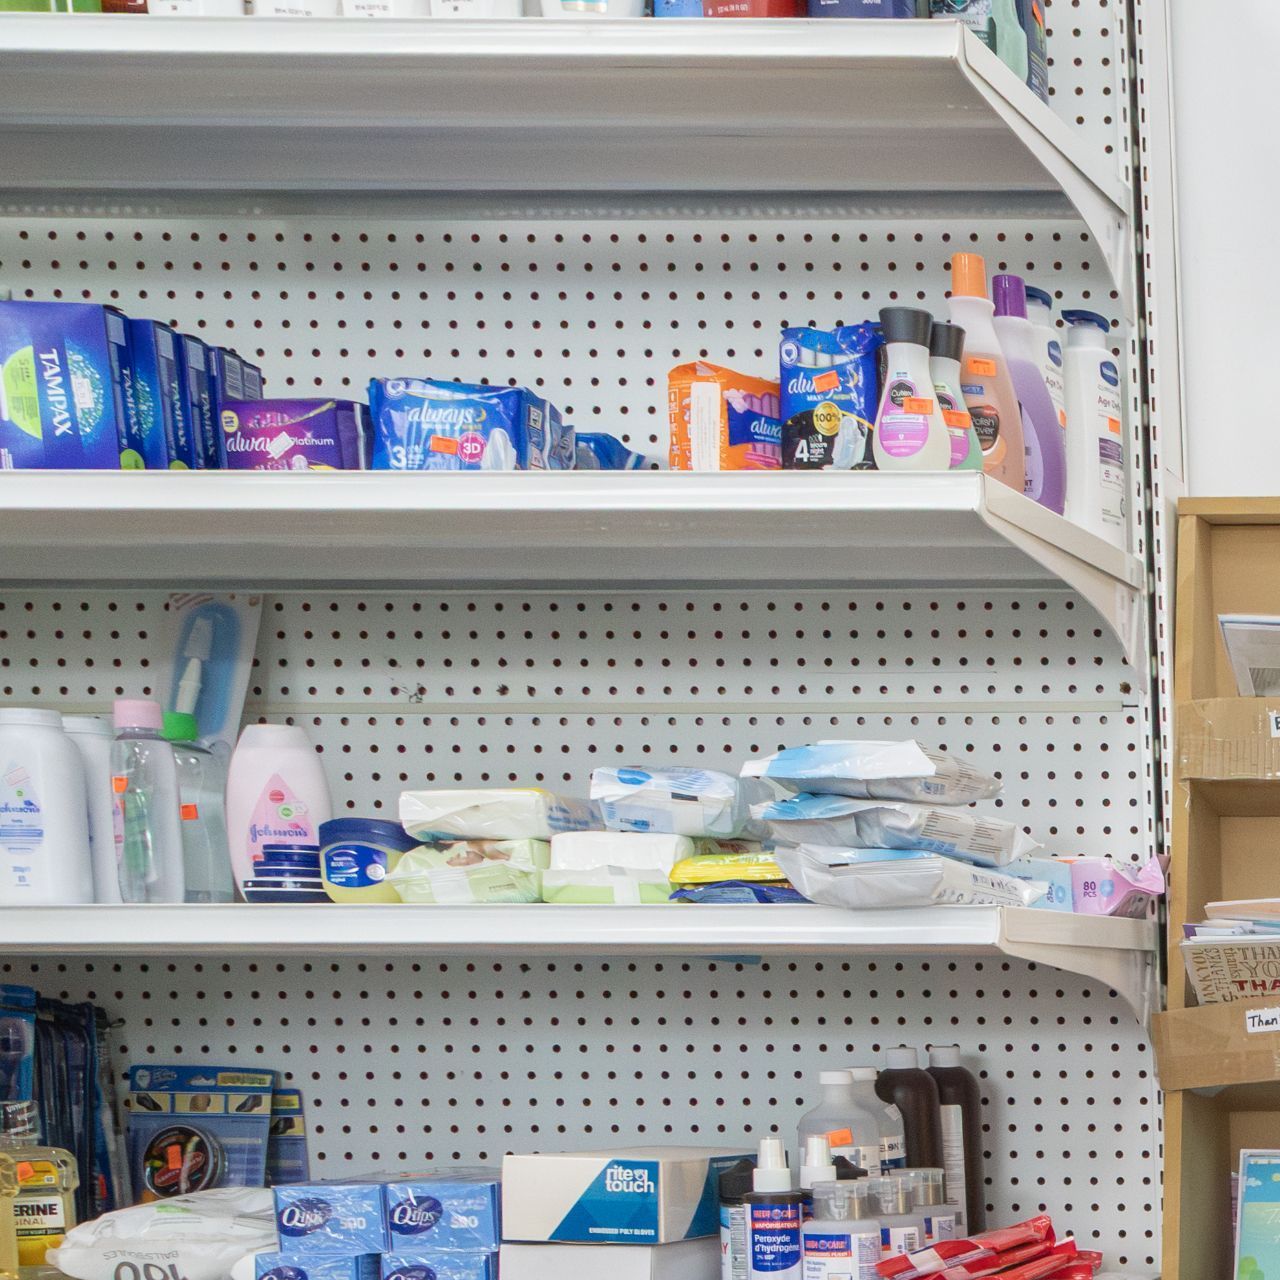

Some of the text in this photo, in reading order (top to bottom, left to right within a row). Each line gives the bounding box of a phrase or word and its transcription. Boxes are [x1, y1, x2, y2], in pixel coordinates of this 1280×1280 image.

[39, 348, 74, 436] TAMPAX
[408, 399, 474, 424] always
[226, 431, 279, 453] alway
[463, 442, 481, 454] 3D
[794, 439, 809, 462] 4
[1082, 880, 1097, 891] 80
[606, 1164, 633, 1181] rite
[605, 1178, 655, 1193] touch
[754, 1234, 790, 1243] Peroxyde
